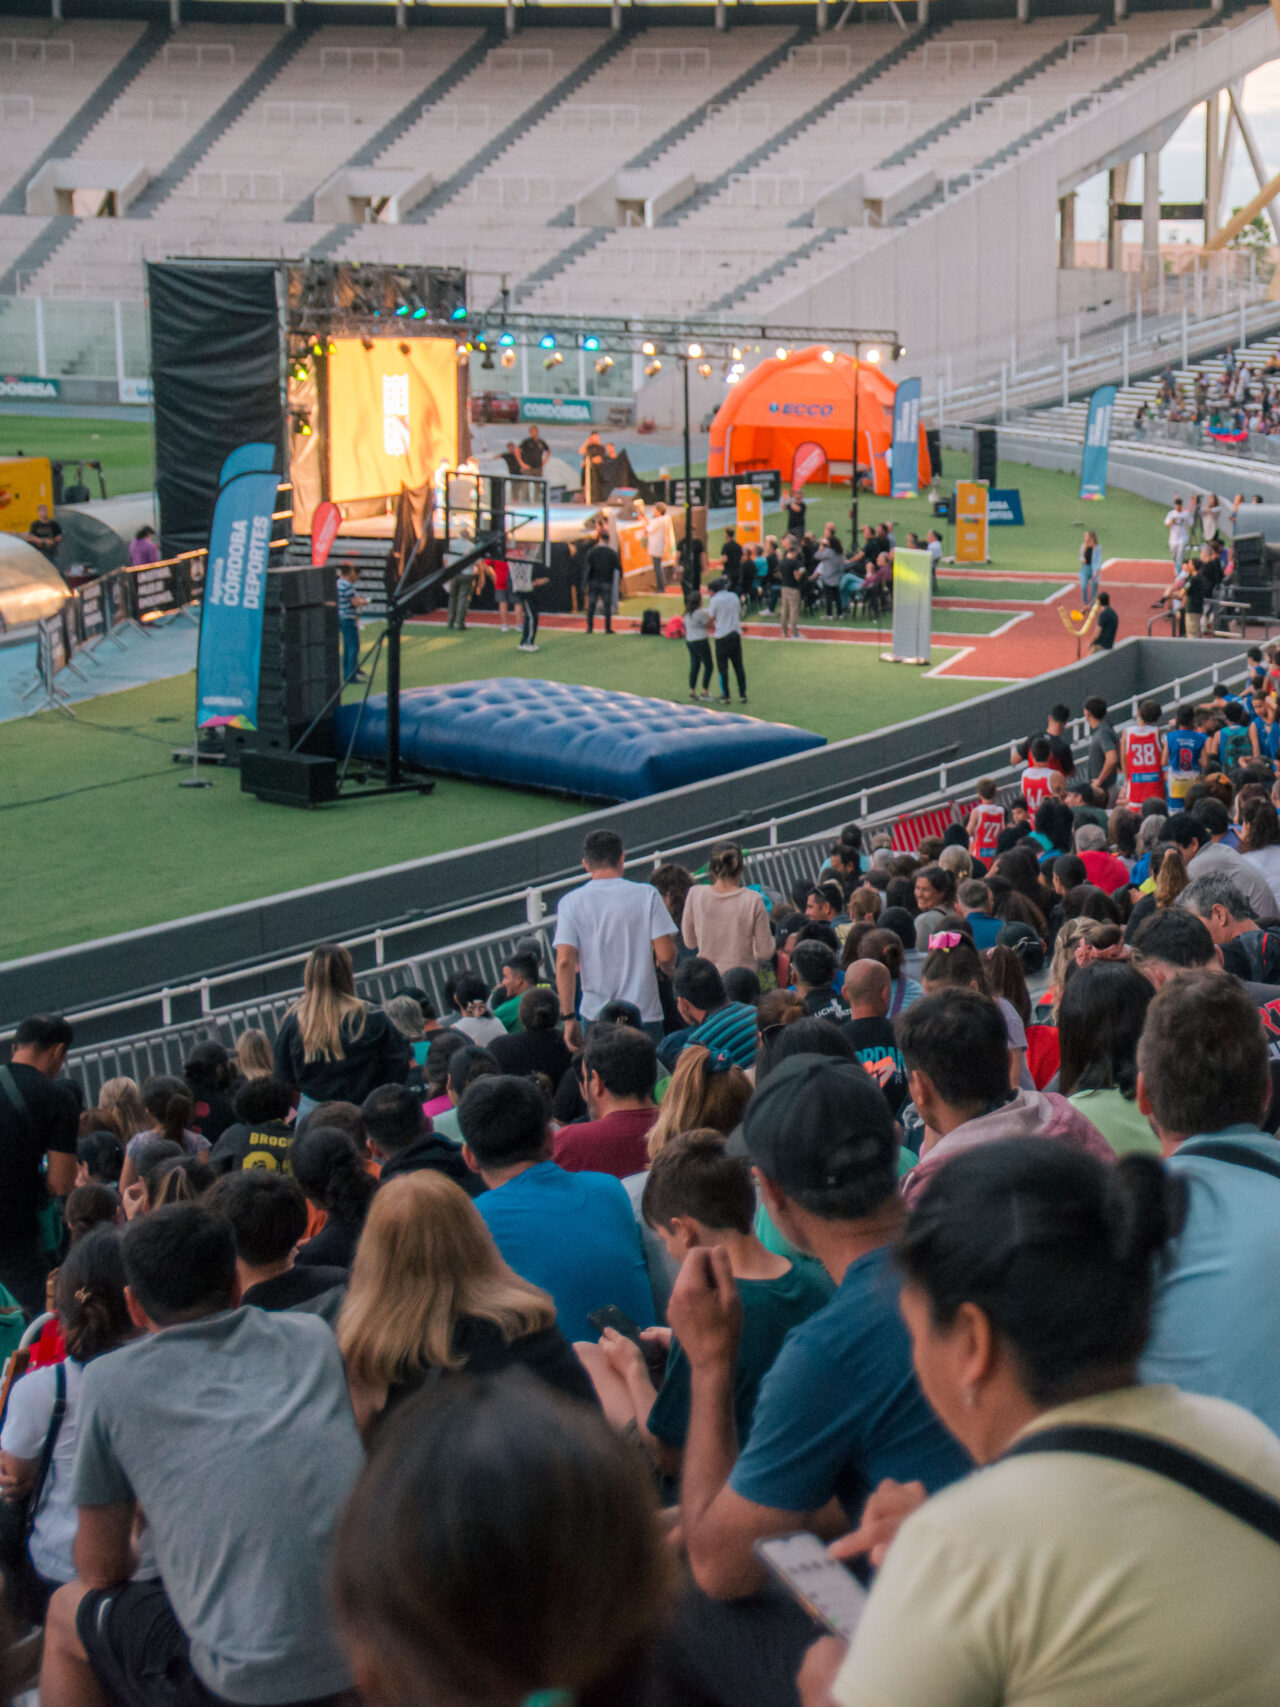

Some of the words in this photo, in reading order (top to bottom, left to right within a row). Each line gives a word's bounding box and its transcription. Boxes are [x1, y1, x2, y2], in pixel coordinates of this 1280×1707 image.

[523, 403, 592, 419] CORDOBESA
[782, 402, 833, 416] ECCO
[223, 519, 249, 607] CÓRDOBA
[243, 515, 269, 610] DEPORTES
[1131, 743, 1156, 767] 38
[1180, 748, 1192, 771] 8
